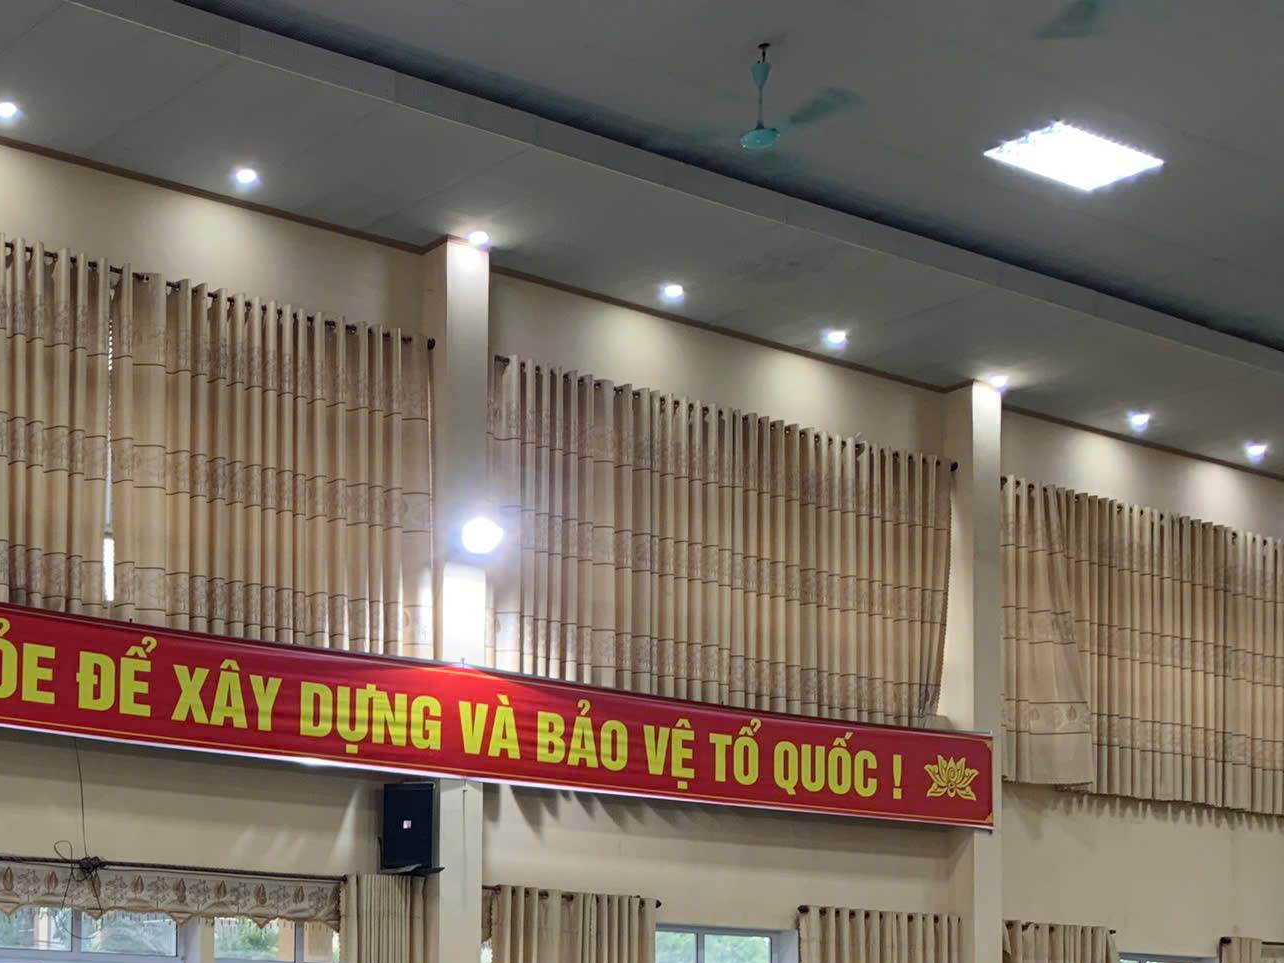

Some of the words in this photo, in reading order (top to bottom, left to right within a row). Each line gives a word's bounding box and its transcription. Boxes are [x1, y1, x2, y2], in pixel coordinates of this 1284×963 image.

[76, 636, 157, 718] ĐỂ
[171, 659, 282, 731] XÂY
[299, 682, 443, 754] DỰNG
[458, 694, 521, 760] VÀ
[536, 700, 628, 771] BẢO
[643, 719, 696, 790] VỆ
[709, 719, 761, 785] TỔ
[773, 732, 877, 797] QUỐC
